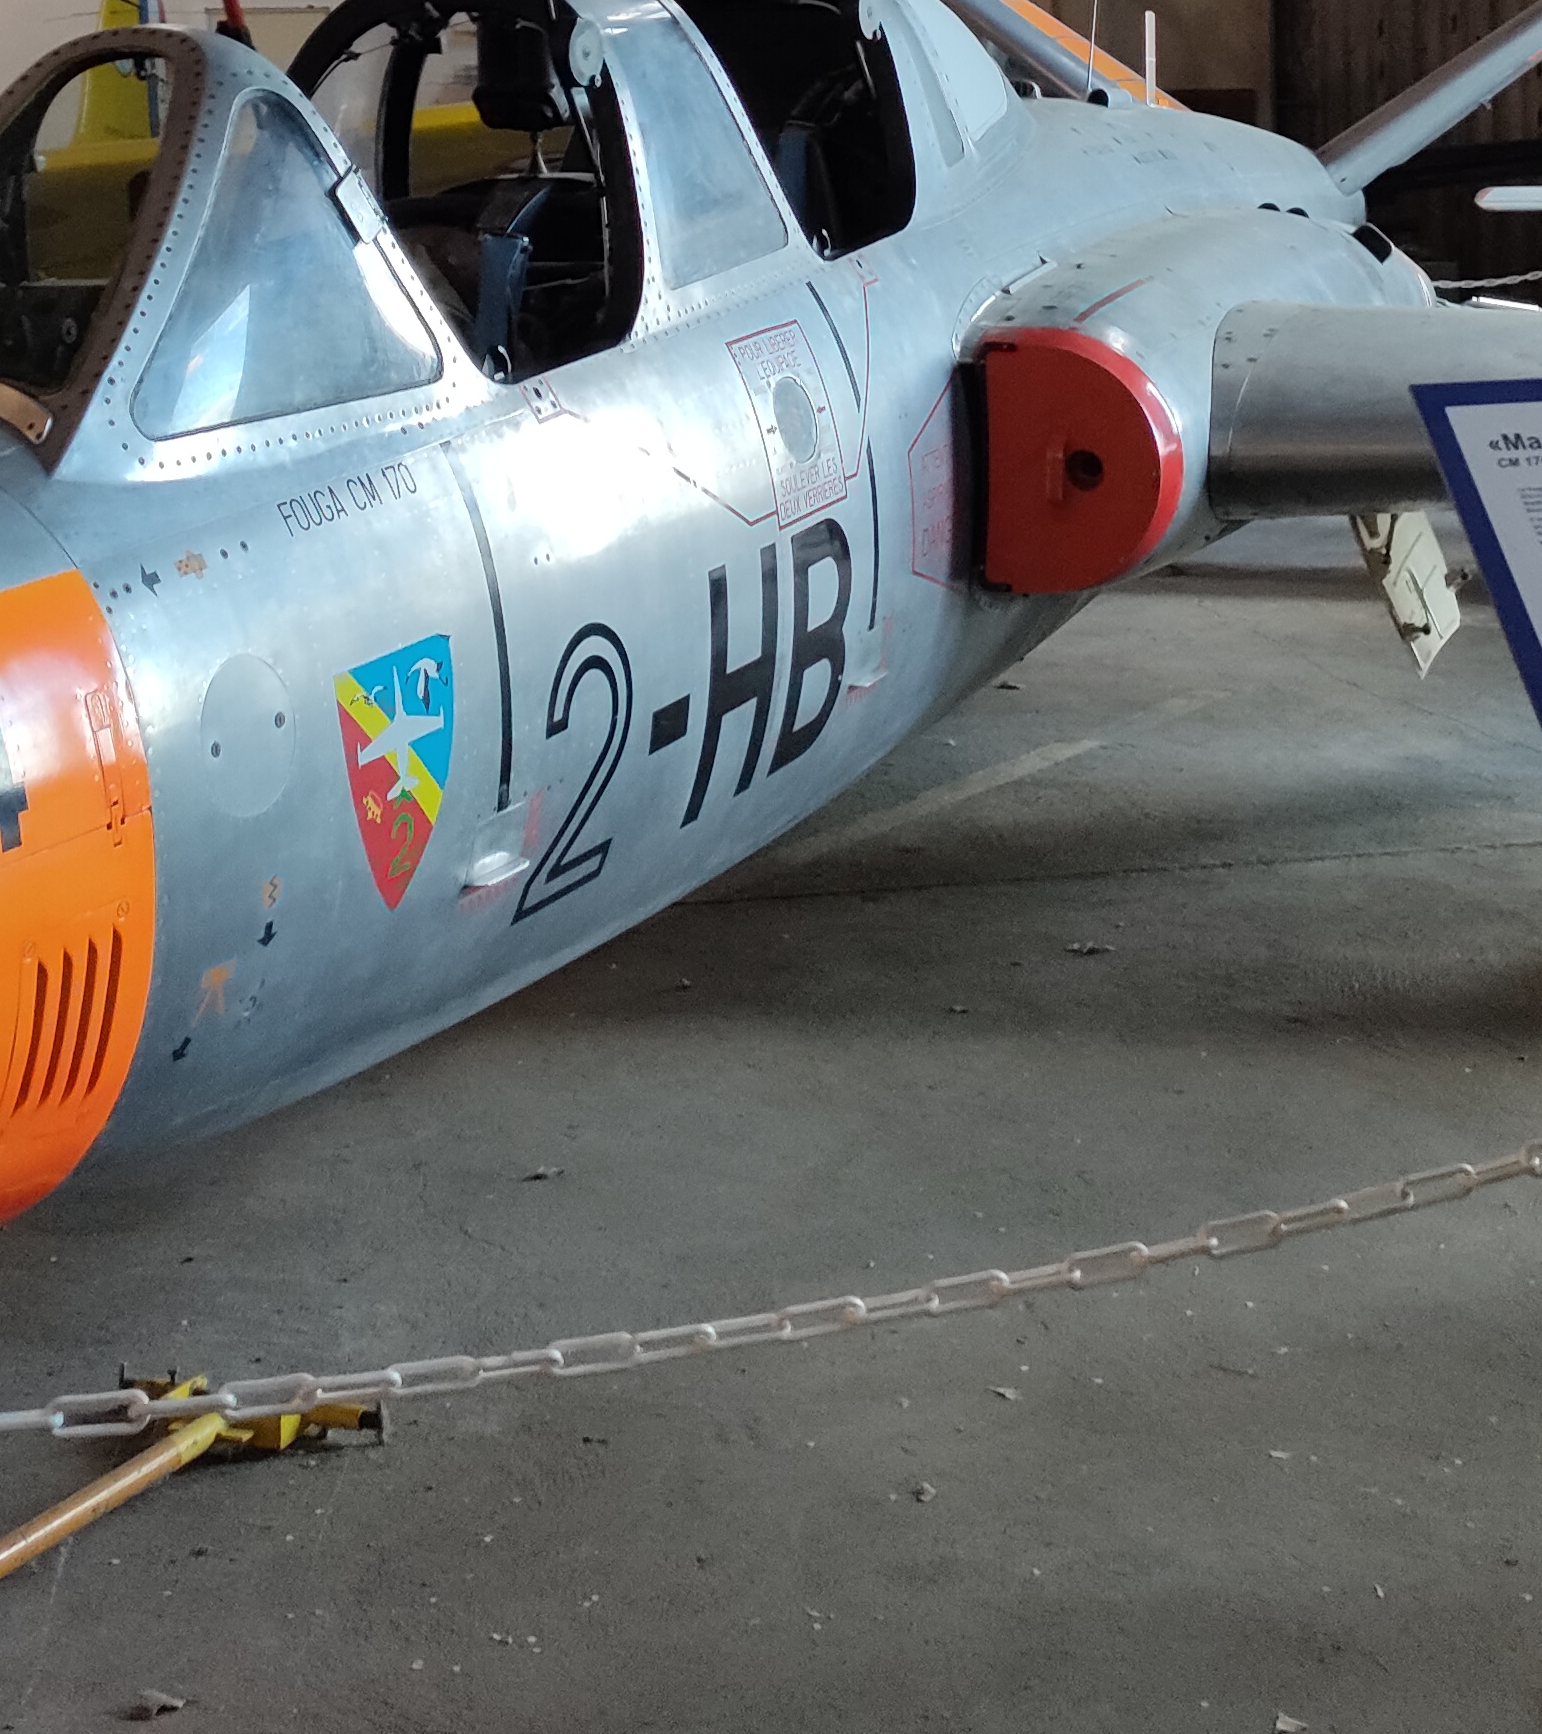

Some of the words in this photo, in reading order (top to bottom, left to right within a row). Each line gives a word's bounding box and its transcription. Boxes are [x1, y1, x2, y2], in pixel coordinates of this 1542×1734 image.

[737, 338, 762, 362] POUR
[1497, 456, 1522, 468] CM
[780, 465, 820, 498] SOULEVER
[820, 456, 839, 478] LES
[275, 484, 349, 538] FOUGA
[346, 472, 384, 511] CM
[380, 460, 418, 501] 170
[779, 495, 802, 522] DEUX
